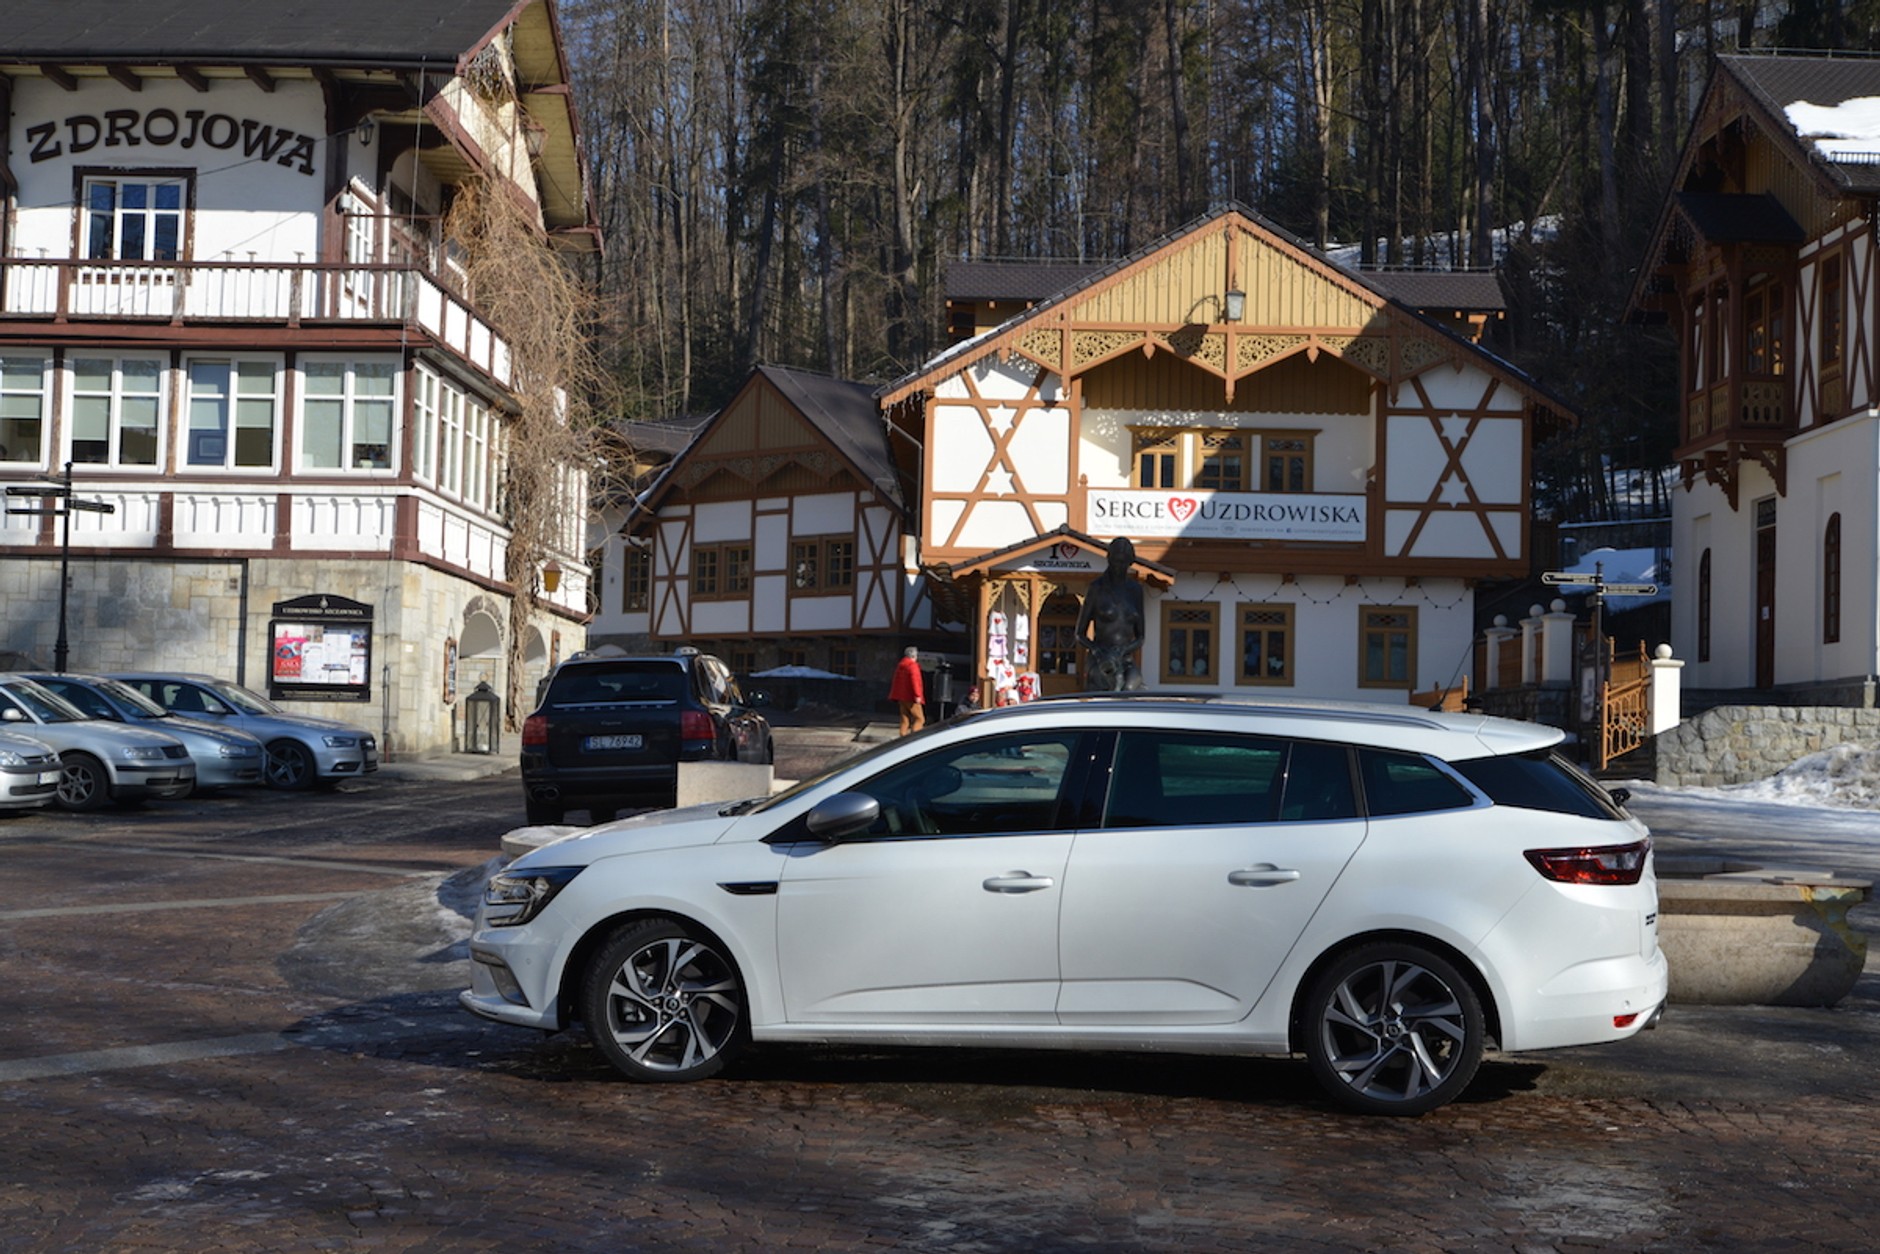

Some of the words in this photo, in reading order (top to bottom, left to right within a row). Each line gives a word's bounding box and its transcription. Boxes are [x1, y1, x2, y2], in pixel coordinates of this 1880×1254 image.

[27, 108, 316, 176] ZDROJOWA
[1095, 498, 1165, 518] SERCE
[1200, 500, 1360, 523] UZDROWISKA
